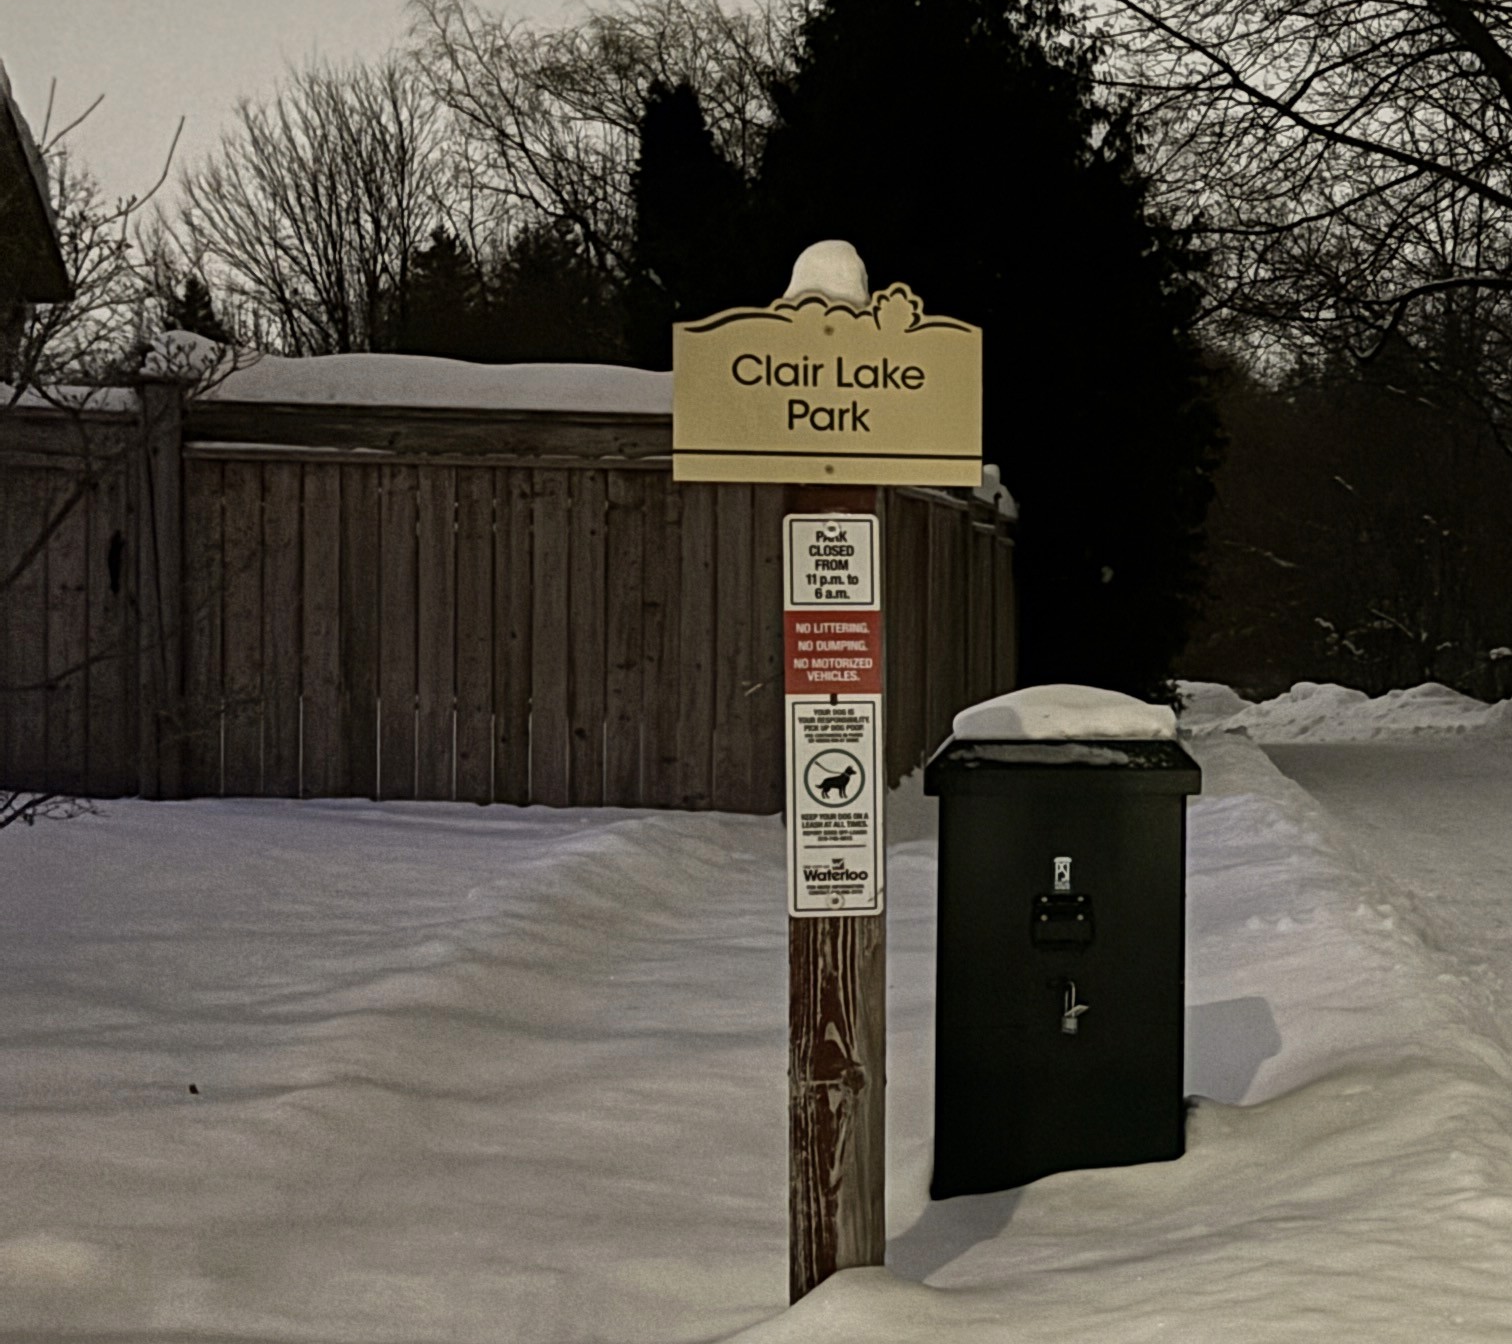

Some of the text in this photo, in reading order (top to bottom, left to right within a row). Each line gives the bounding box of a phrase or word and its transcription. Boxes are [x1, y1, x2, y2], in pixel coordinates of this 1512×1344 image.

[732, 354, 925, 389] Clair Lake
[788, 399, 870, 432] Park
[809, 545, 854, 556] CLOSED
[815, 559, 849, 571] FROM
[806, 573, 859, 587] 11 p.m. to
[815, 588, 850, 599] 6 a.m.
[795, 622, 870, 633] NO LITTERING.
[797, 640, 868, 651] NO DUMPING.
[793, 658, 873, 669] NO MOTORIZED
[807, 670, 861, 681] VEHICLES.
[803, 869, 868, 881] Waterloo
